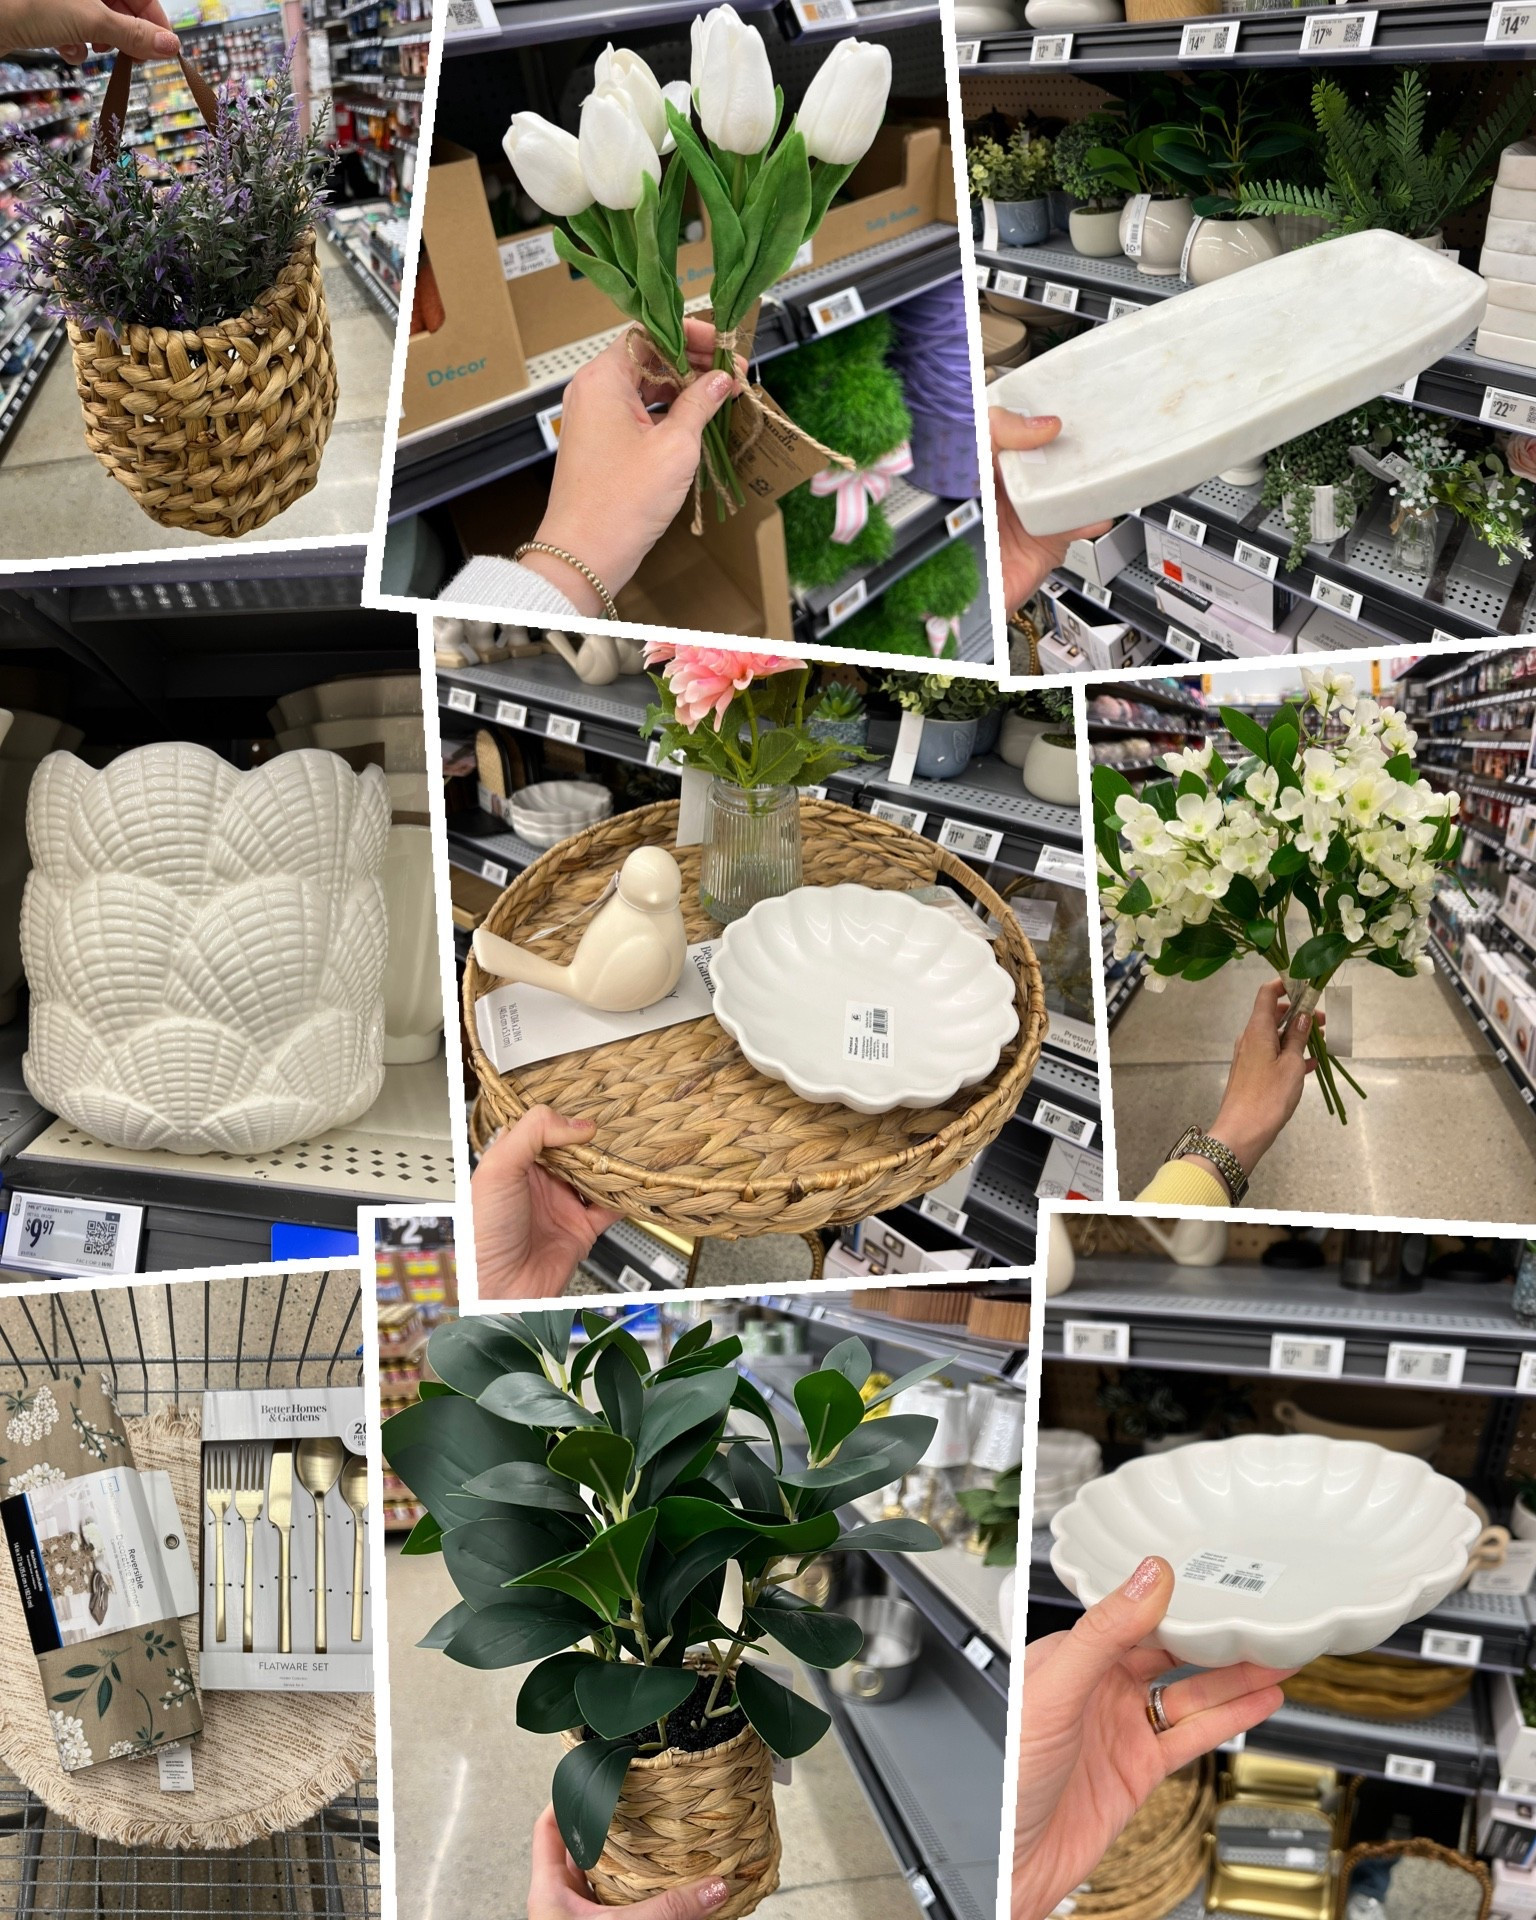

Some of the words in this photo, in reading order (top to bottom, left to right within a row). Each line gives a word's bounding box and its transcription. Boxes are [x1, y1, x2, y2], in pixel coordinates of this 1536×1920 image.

[426, 357, 487, 387] Décor
[1051, 1033, 1071, 1047] Glass
[1073, 1041, 1092, 1054] Wall
[1064, 1029, 1095, 1047] Pressed
[261, 1404, 290, 1415] Better
[291, 1403, 327, 1413] Homes
[268, 1413, 277, 1423] &
[277, 1412, 320, 1423] Gardens
[128, 1548, 145, 1589] Reversible
[258, 1661, 308, 1671] FLATWARE
[312, 1662, 329, 1672] SET
